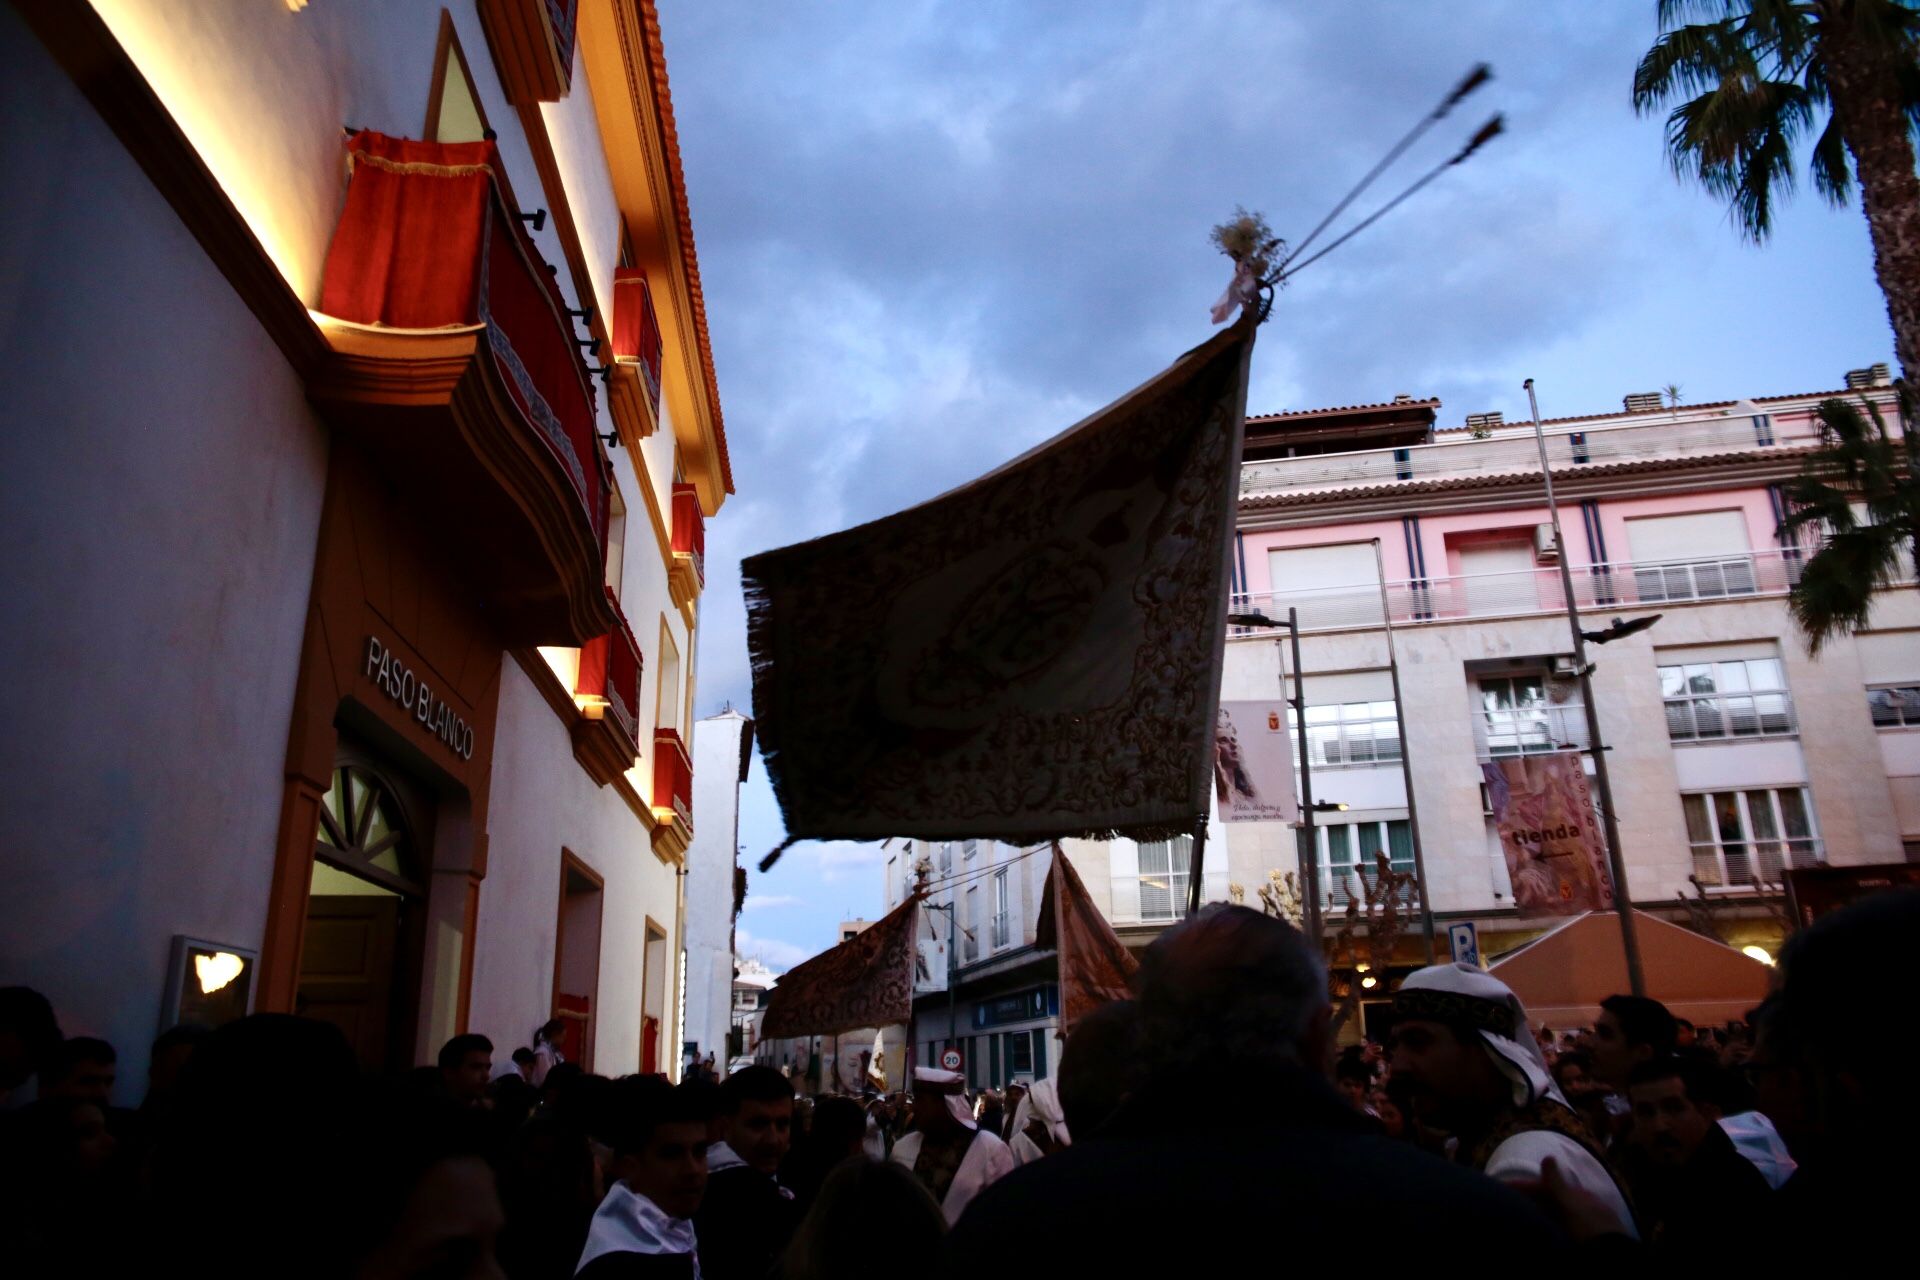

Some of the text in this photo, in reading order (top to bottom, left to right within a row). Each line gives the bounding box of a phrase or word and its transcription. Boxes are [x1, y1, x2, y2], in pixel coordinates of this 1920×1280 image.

[367, 635, 474, 761] PASO BLANCO
[1512, 824, 1580, 846] tienda
[1571, 755, 1612, 900] paso blanco
[1453, 926, 1474, 962] P
[945, 1056, 958, 1065] 20
